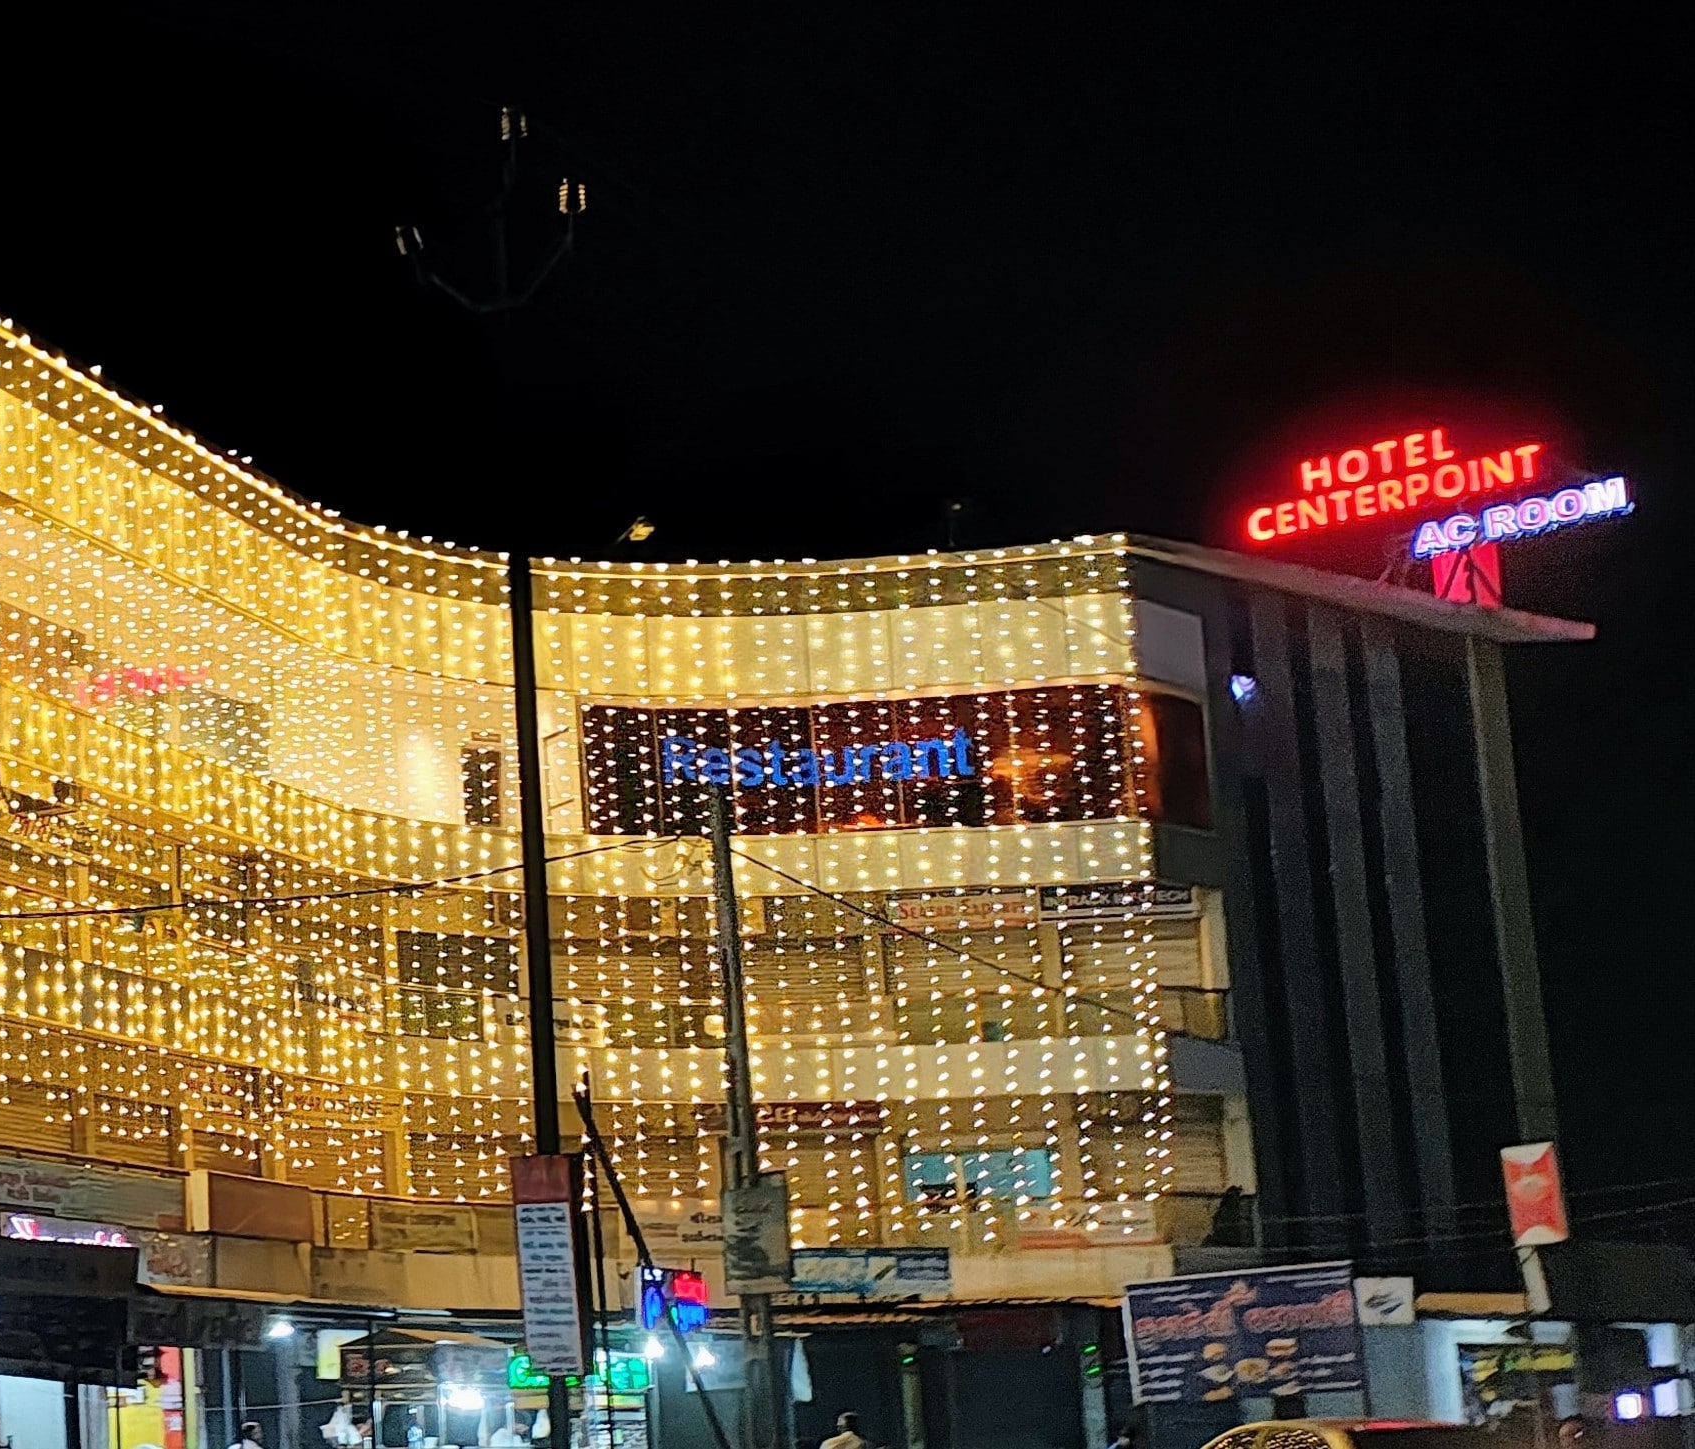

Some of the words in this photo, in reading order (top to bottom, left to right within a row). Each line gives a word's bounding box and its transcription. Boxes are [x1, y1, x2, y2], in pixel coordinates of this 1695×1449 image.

[1247, 445, 1541, 541] CENTERPOINT
[1301, 429, 1455, 491] HOTEL
[1415, 516, 1476, 557] AC
[1484, 477, 1630, 540] ROOM
[662, 726, 976, 787] Restaurant
